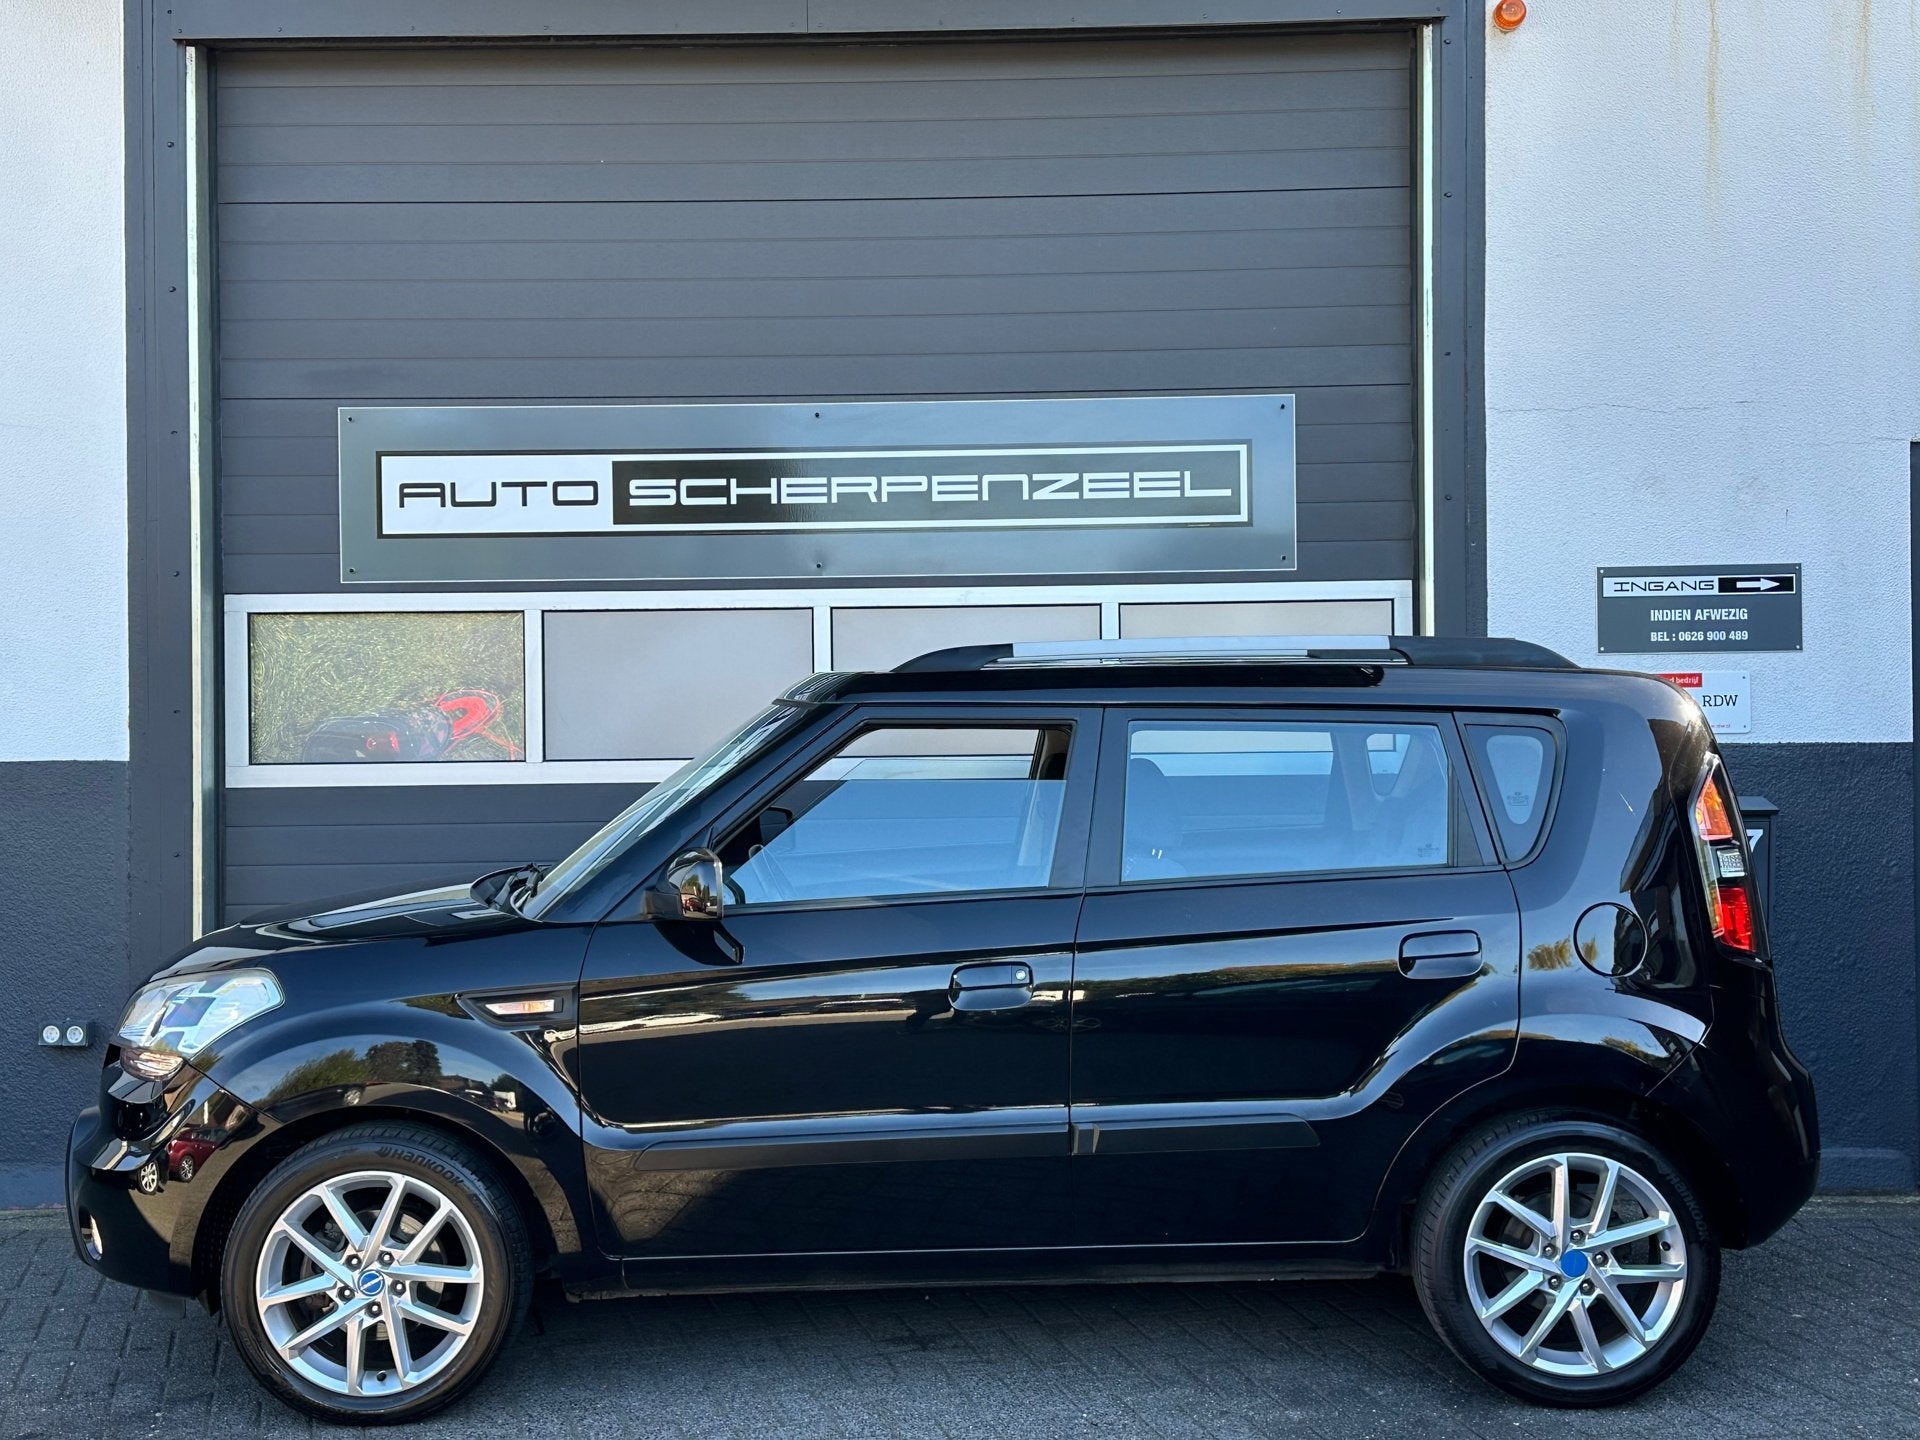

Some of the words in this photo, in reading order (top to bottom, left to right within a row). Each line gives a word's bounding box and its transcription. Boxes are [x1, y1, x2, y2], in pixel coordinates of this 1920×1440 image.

[398, 480, 599, 509] AUTO
[628, 470, 1232, 507] SCHERPENZEEL
[1613, 580, 1714, 592] INGANG
[1650, 609, 1691, 622] INDIEN
[1694, 608, 1748, 621] AFWEZIG
[1650, 631, 1670, 642] BEL
[1678, 630, 1704, 641] 0626
[1706, 630, 1726, 641] 900
[1728, 629, 1749, 641] 489
[1702, 694, 1739, 707] RDW
[1745, 828, 1764, 853] 7
